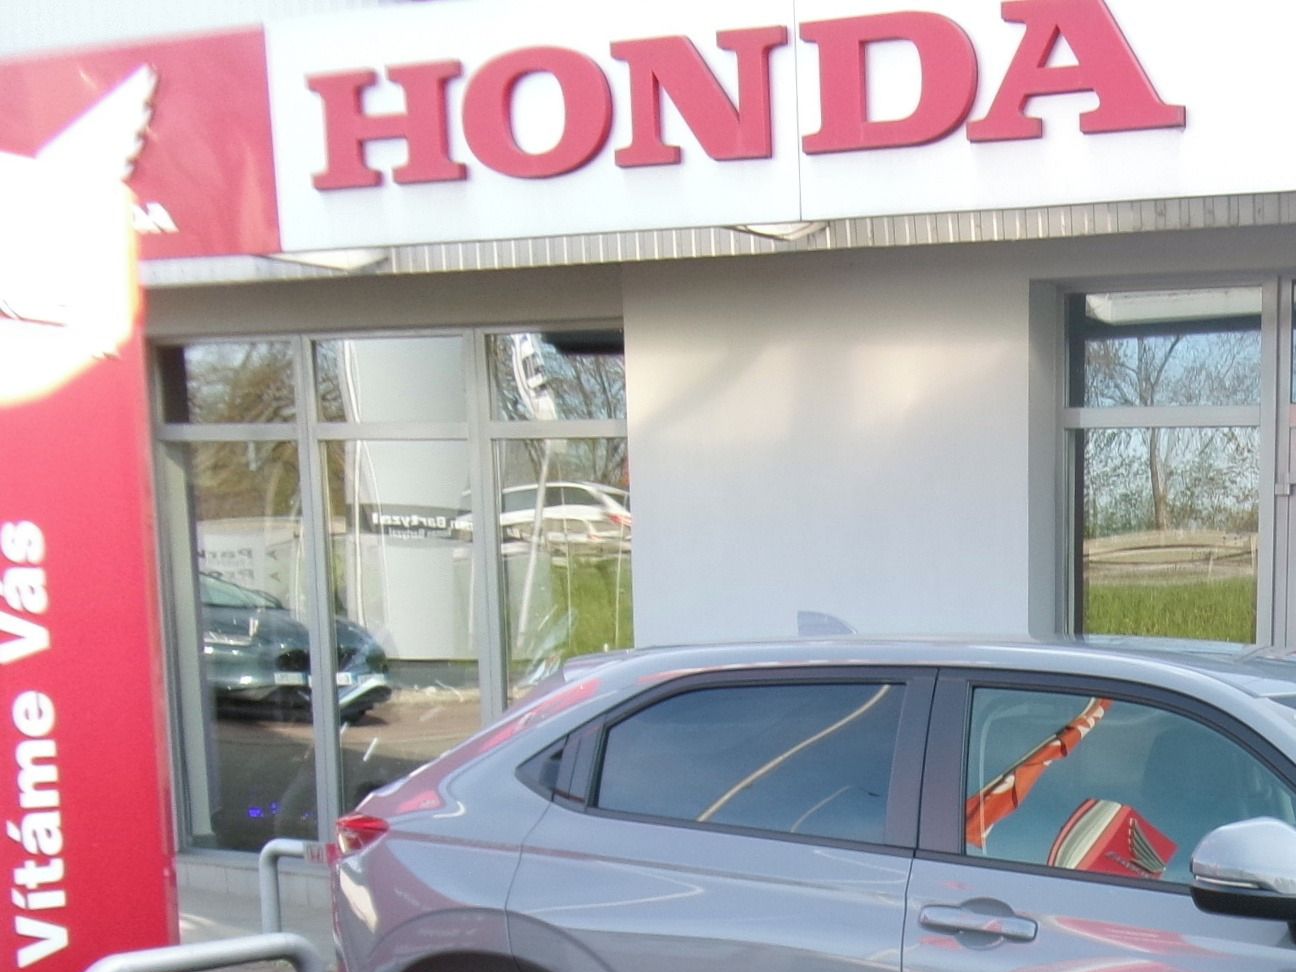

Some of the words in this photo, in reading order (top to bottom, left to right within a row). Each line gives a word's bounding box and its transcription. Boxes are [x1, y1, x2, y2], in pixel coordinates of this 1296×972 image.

[307, 0, 1186, 190] HONDA
[0, 519, 51, 665] Vás
[7, 689, 69, 969] Vítáme
